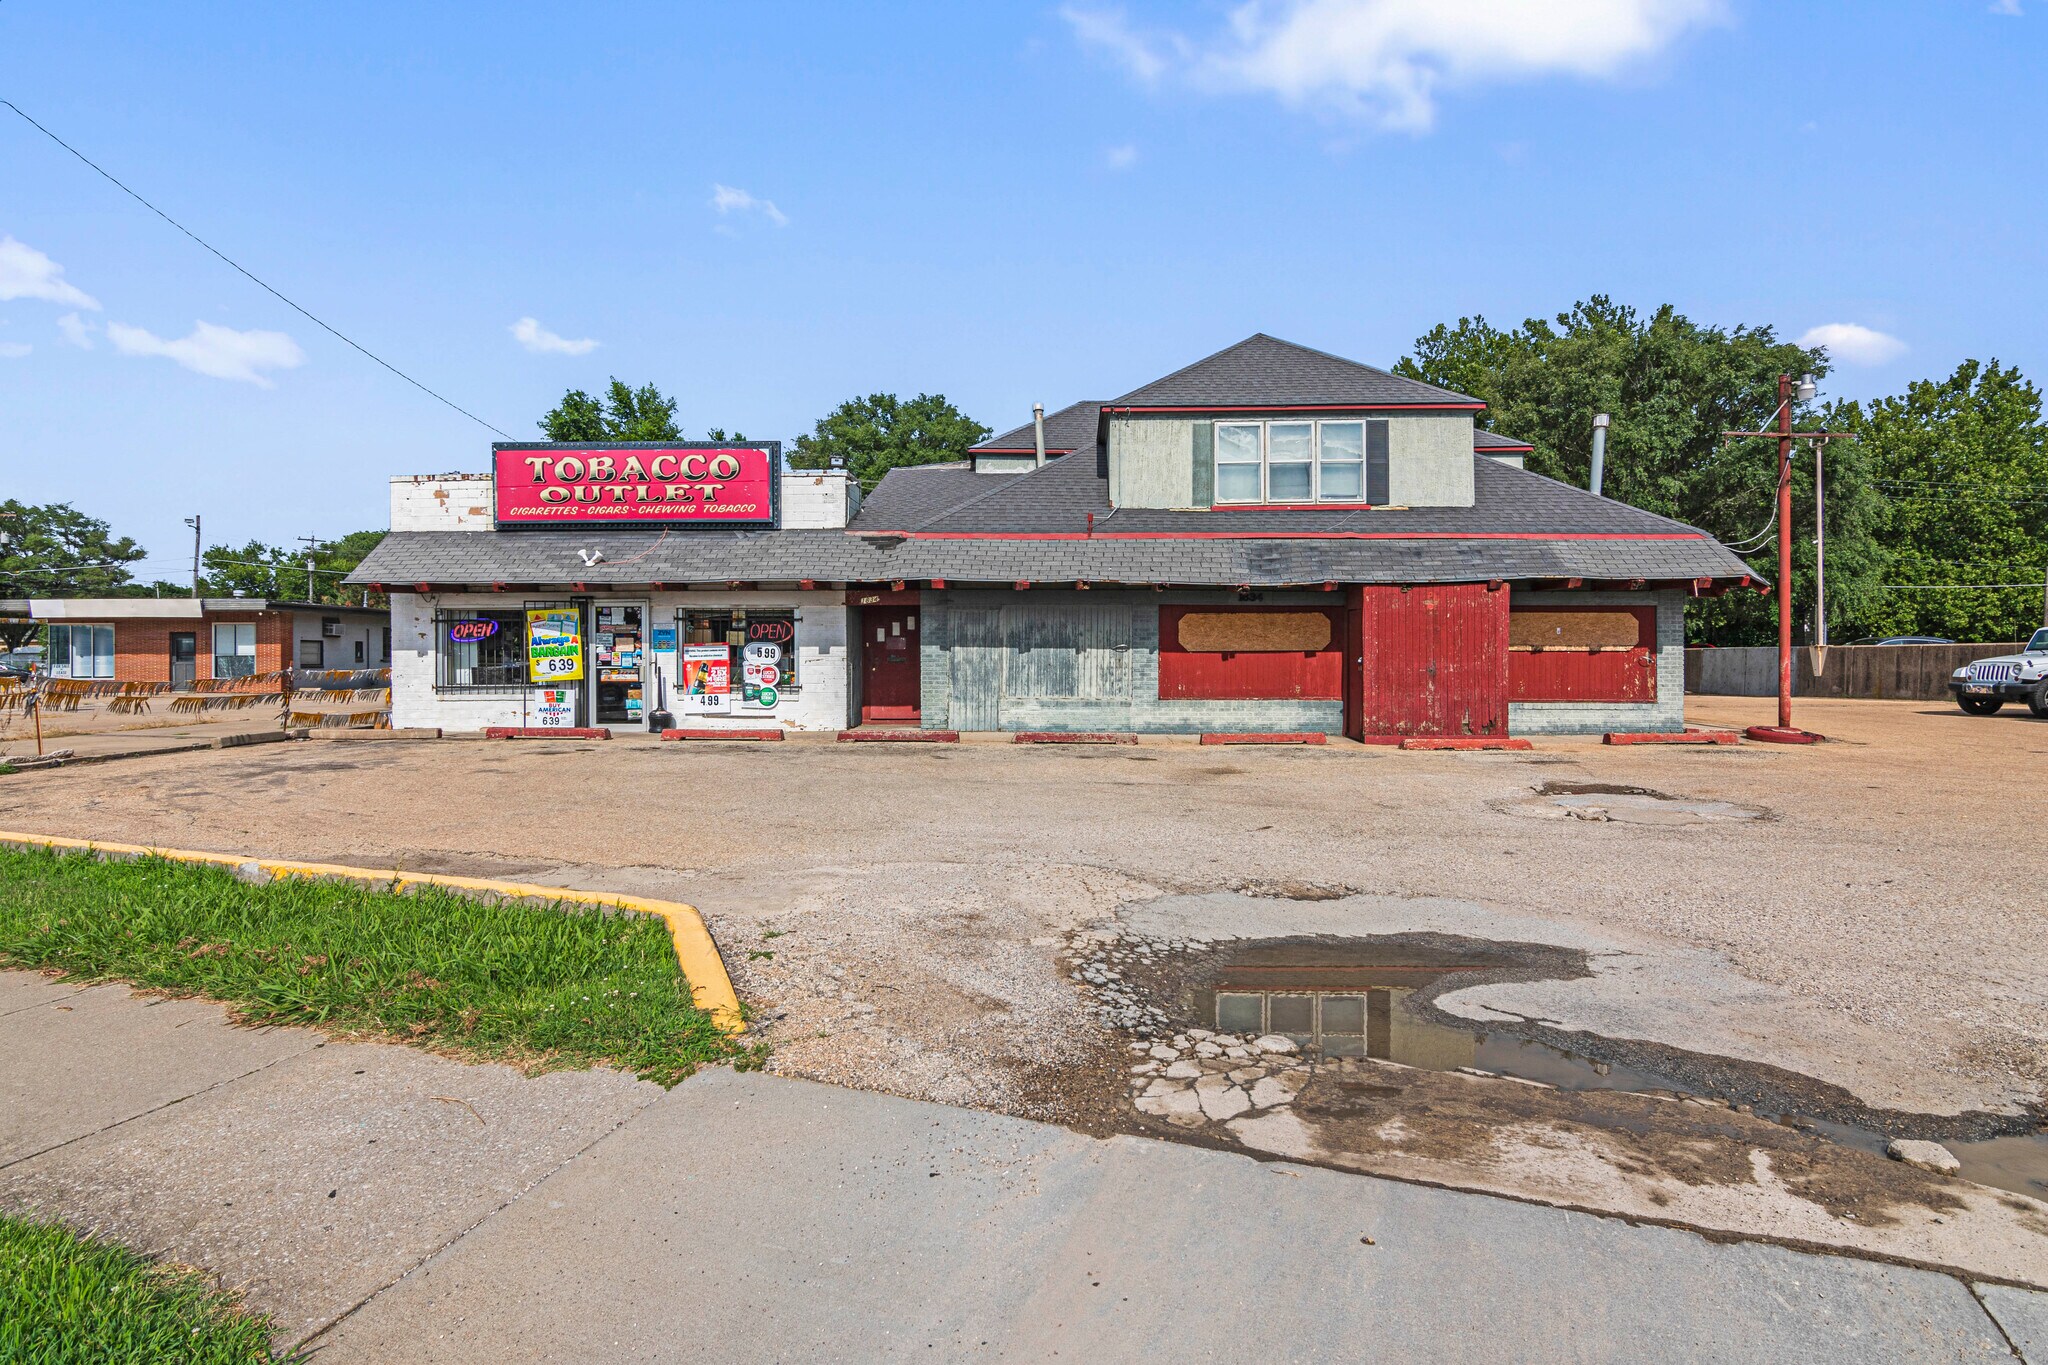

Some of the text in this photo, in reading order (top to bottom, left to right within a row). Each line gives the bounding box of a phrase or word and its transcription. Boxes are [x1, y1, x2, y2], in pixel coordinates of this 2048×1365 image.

[524, 454, 741, 483] TOBACCO
[539, 484, 725, 504] OUTLET
[510, 506, 579, 515] CIGARETTES
[587, 505, 629, 514] CIGARS
[638, 504, 697, 514] CHEWING
[703, 503, 757, 513] TOBACCO
[453, 623, 493, 638] OPEN
[750, 623, 787, 639] OPEN
[531, 635, 579, 646] Always A
[530, 645, 579, 658] BARGAIN
